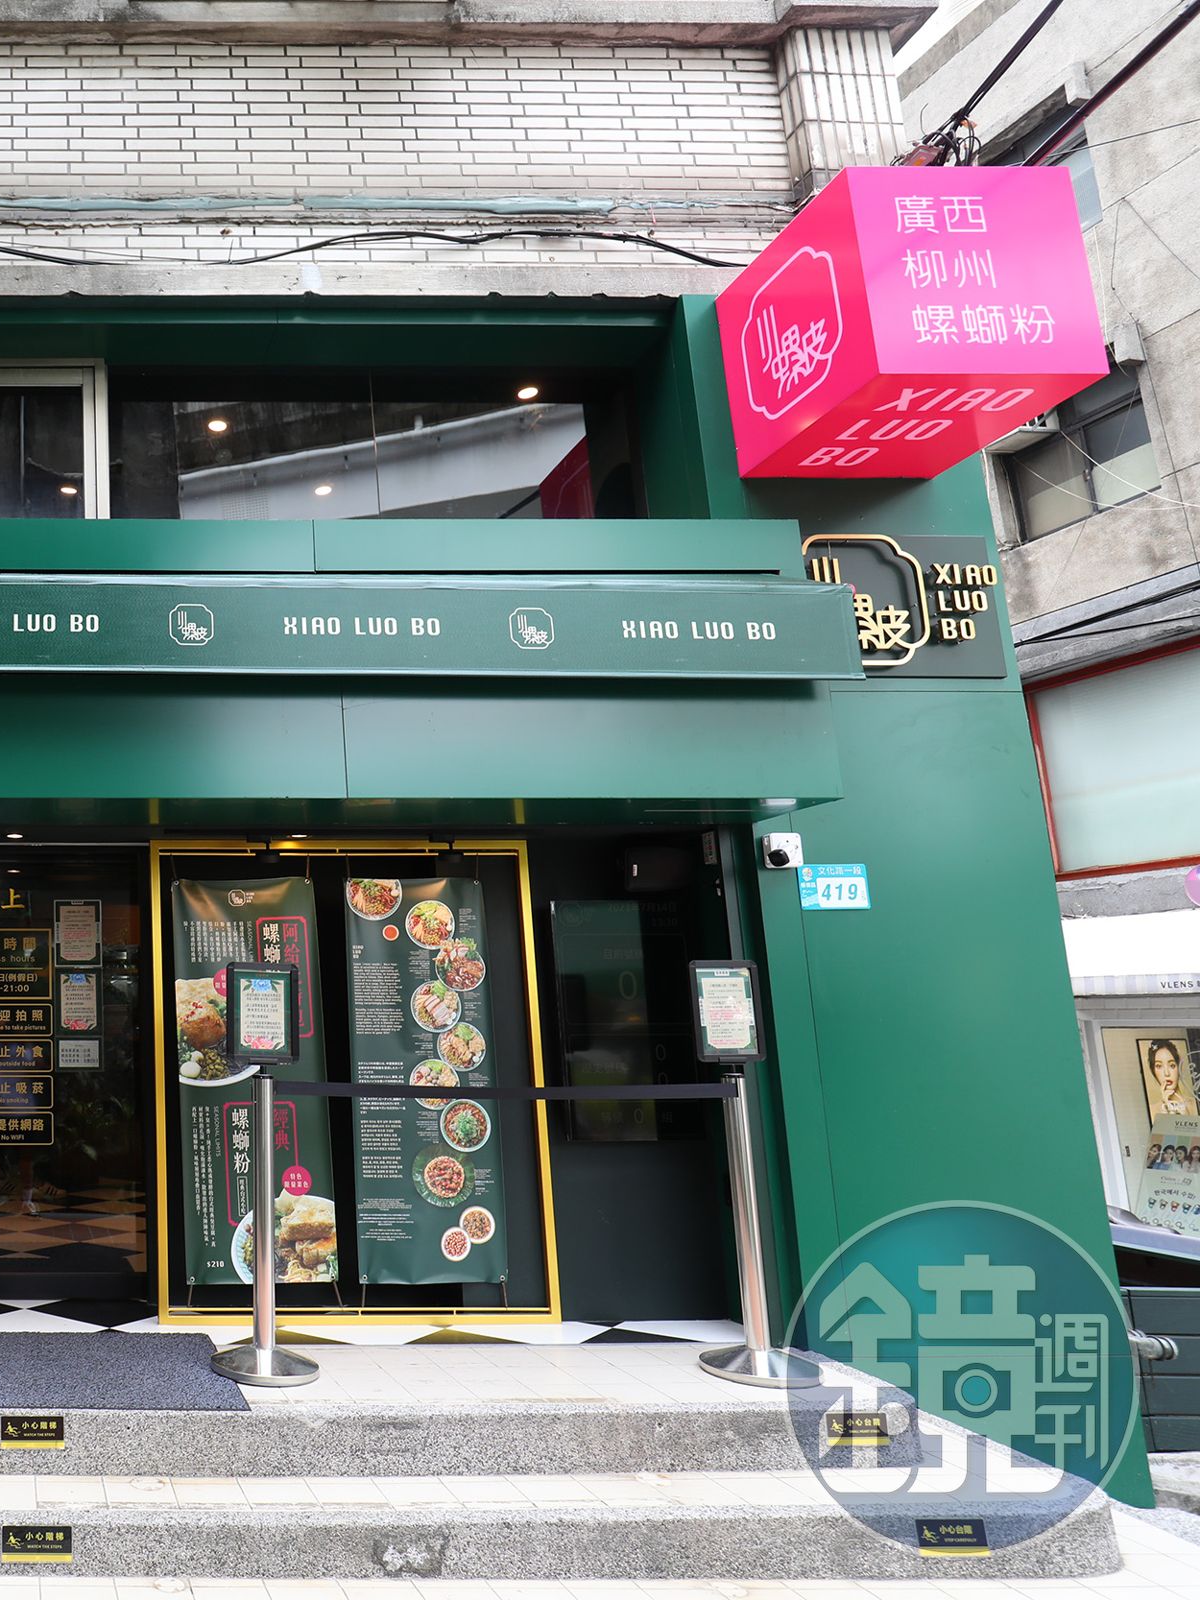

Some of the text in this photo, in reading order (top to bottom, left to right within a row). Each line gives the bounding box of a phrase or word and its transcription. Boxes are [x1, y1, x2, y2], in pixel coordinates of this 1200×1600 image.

[895, 195, 986, 234] 廣西
[902, 249, 996, 289] 柳州
[912, 303, 1056, 345] 螺螄粉
[873, 388, 1035, 412] XIAO
[835, 419, 953, 440] LUO
[798, 447, 879, 466] BO
[932, 562, 998, 587] XIAO
[939, 590, 989, 612] LUO
[13, 613, 56, 632] LUO
[70, 614, 99, 633] BO
[283, 616, 441, 636] XIAO LUO BO
[621, 620, 776, 640] XIAO LUO BO
[940, 618, 977, 640] BO
[817, 866, 862, 876] 文化路一段
[821, 883, 858, 901] 419
[262, 923, 281, 964] 螺螄
[10, 954, 36, 963] hours
[1160, 980, 1194, 989] VLENS
[25, 1024, 46, 1032] pictures
[274, 1109, 290, 1150] 經典
[231, 1108, 251, 1174] 螺螄粉
[21, 1421, 57, 1430] 小心階梯
[846, 1418, 881, 1426] 小心台階
[25, 1531, 64, 1541] 小心階梯
[939, 1525, 973, 1535] 小心台階
